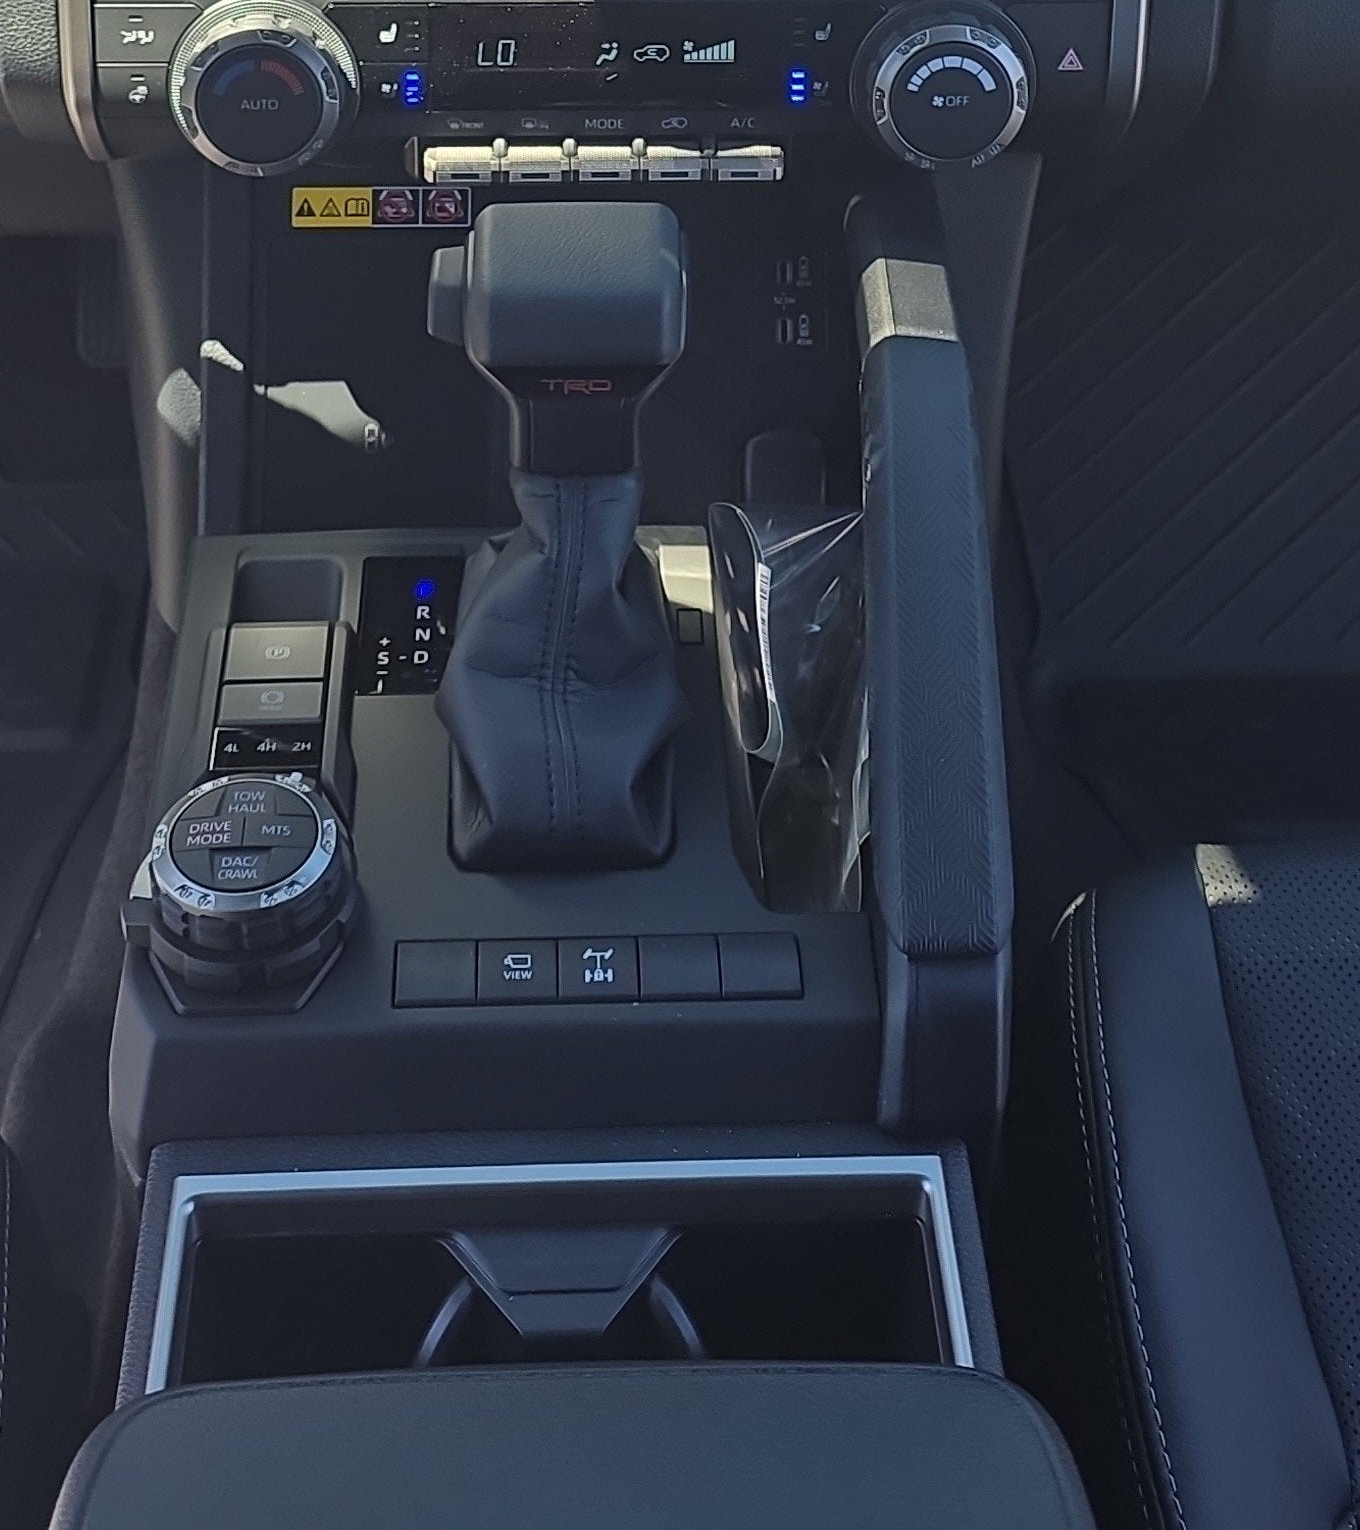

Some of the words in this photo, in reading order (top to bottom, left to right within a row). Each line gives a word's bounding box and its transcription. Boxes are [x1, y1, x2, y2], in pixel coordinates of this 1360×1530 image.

[477, 39, 517, 67] LO
[241, 98, 279, 111] AUTO
[945, 95, 970, 107] OFF
[585, 119, 623, 129] MODE
[730, 117, 755, 128] A/C
[540, 378, 612, 395] TRD
[416, 605, 431, 620] R
[415, 628, 431, 641] N
[377, 651, 390, 665] S
[413, 650, 429, 664] D
[223, 743, 240, 753] 4L
[257, 741, 277, 752] 4H
[292, 741, 312, 752] 2H
[233, 790, 266, 802] TOW
[228, 802, 266, 814] HAUL
[190, 821, 232, 833] DRIVE
[261, 825, 291, 836] MTS
[187, 833, 231, 846] MODE
[221, 856, 259, 868] DAC/
[217, 869, 259, 880] CRAWL
[503, 970, 533, 981] VIEW
